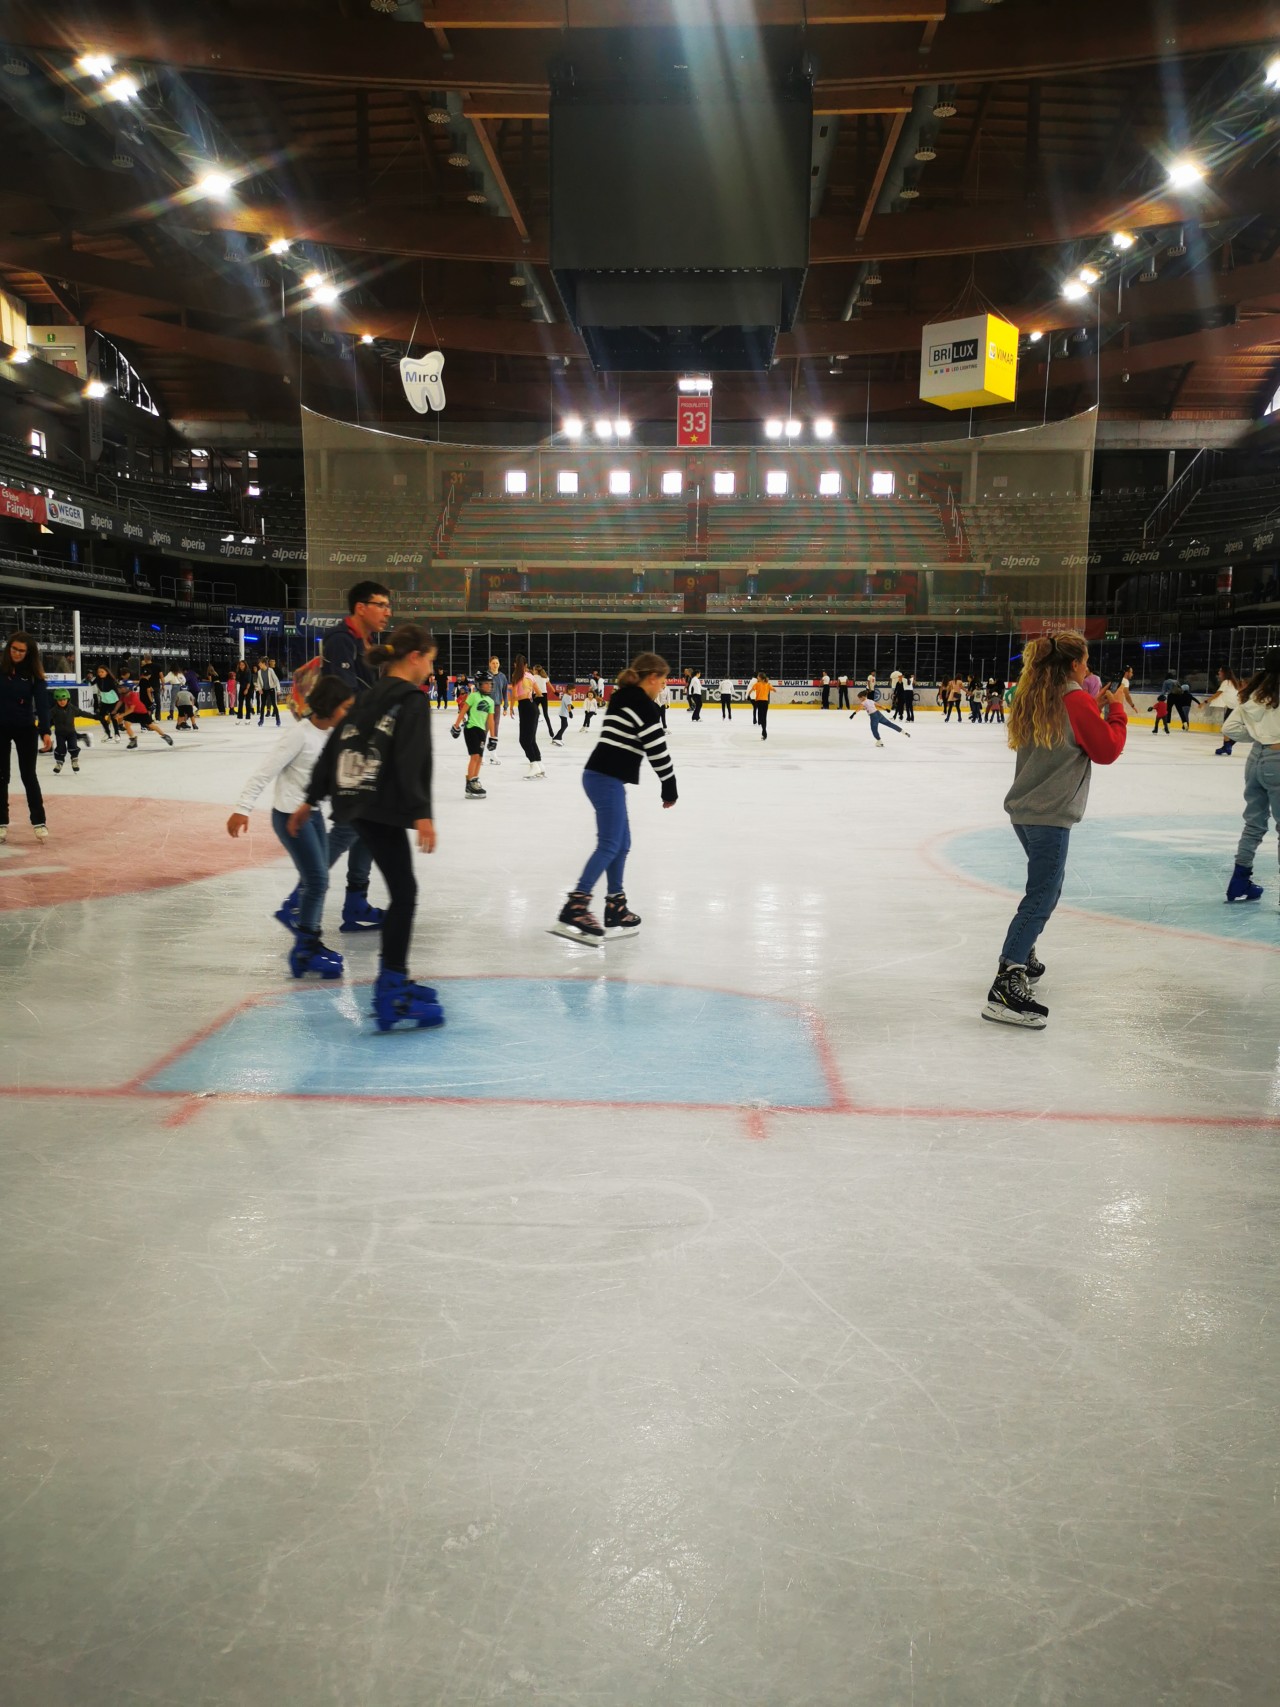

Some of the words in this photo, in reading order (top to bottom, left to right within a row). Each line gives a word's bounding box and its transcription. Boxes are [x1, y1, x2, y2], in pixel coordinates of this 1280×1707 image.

[405, 371, 439, 383] Miro
[682, 411, 706, 432] 33
[6, 501, 34, 519] Fairplay
[58, 502, 82, 520] WEGER
[90, 513, 113, 530] alperia
[123, 521, 143, 538] alperia
[152, 529, 172, 545] alperia
[181, 537, 206, 551] alperia
[220, 543, 253, 557] alperia
[271, 548, 309, 561] alperia
[1122, 550, 1160, 564] alperia
[1178, 544, 1210, 561] alperia
[329, 551, 367, 564] alperia
[386, 551, 424, 565] alperia
[1000, 555, 1041, 568] alperia
[1061, 552, 1102, 568] alperia
[687, 577, 696, 590] 9
[229, 613, 280, 625] LATEMAR
